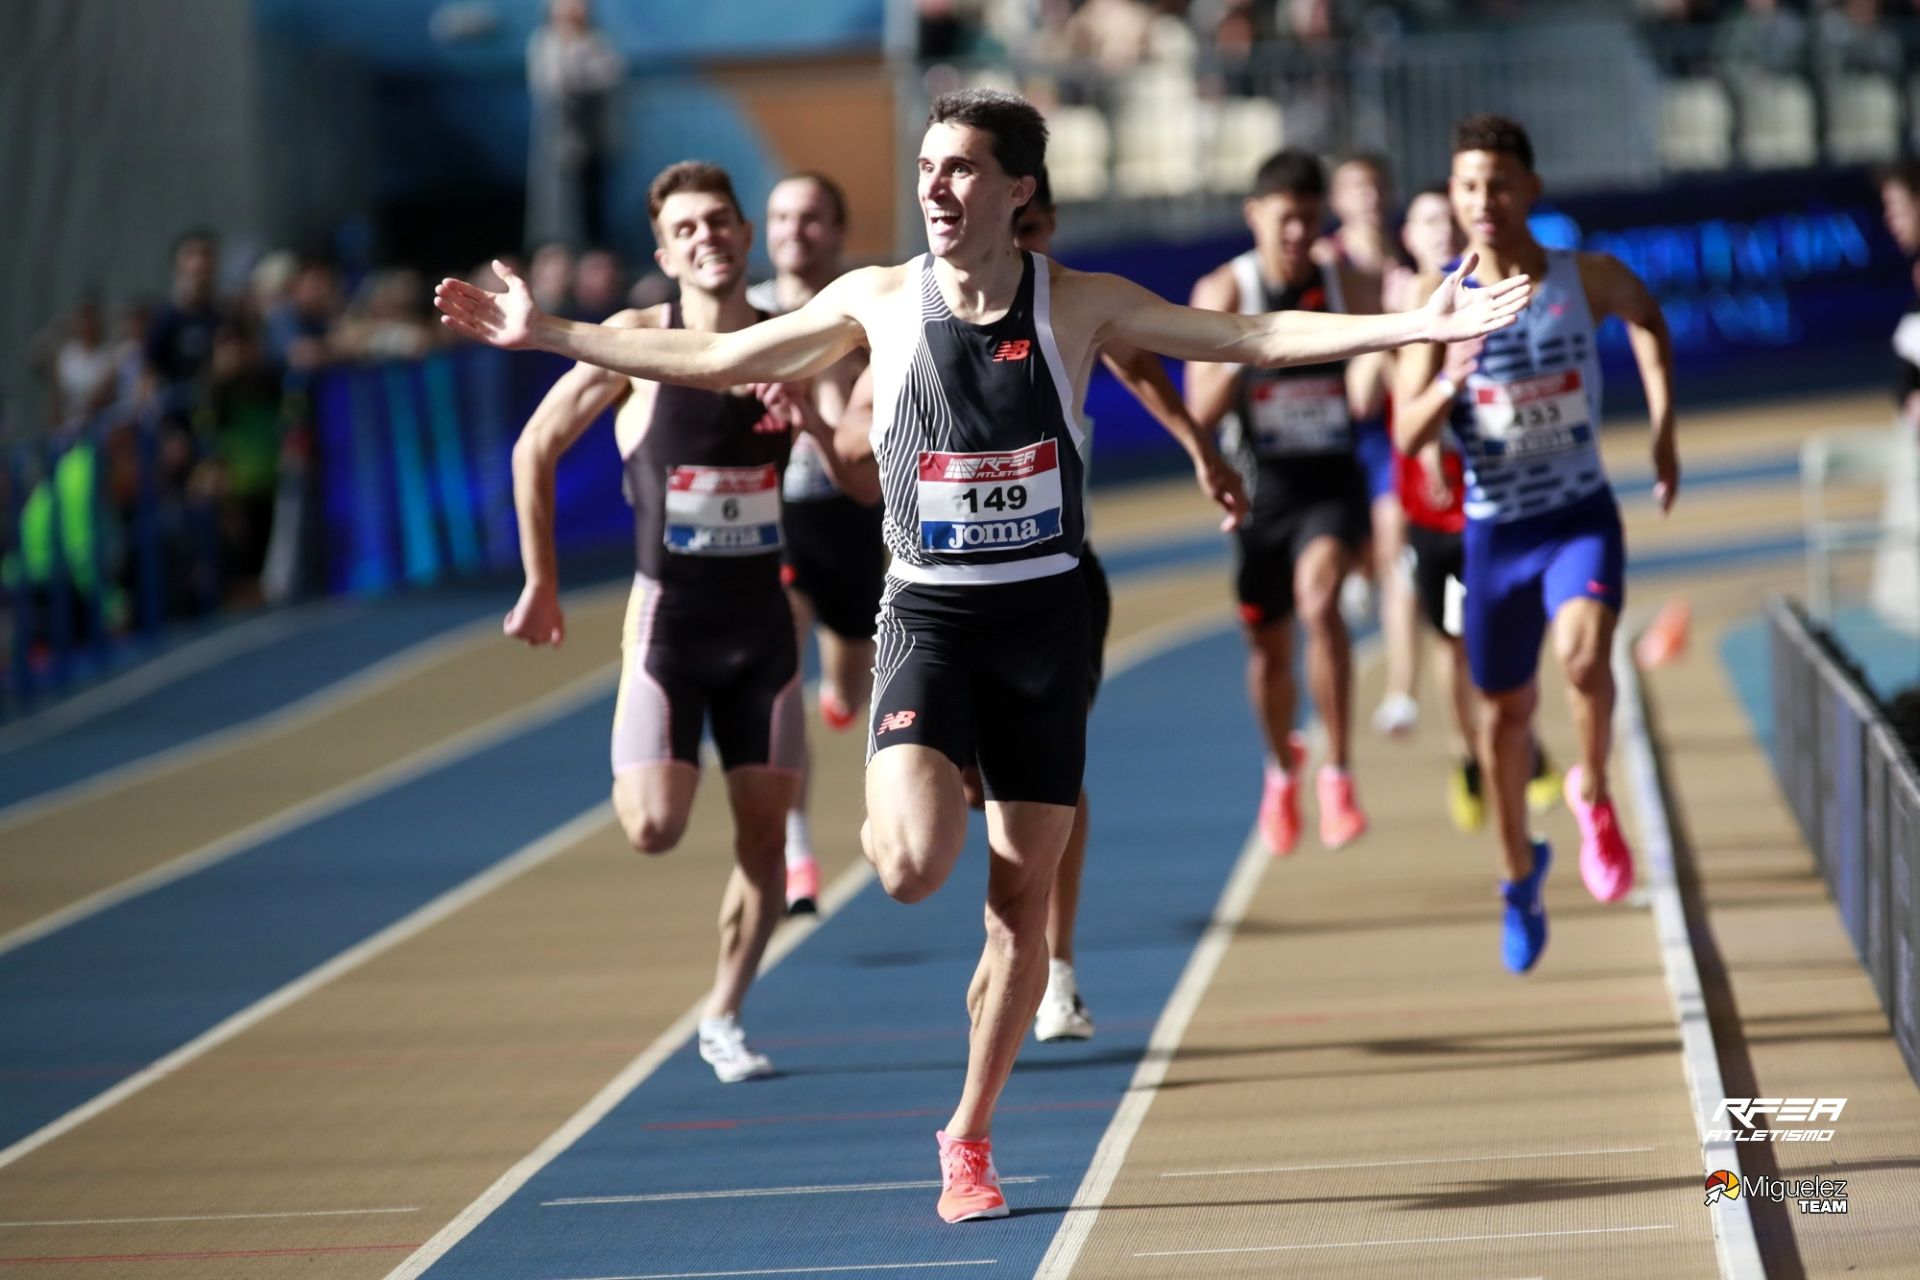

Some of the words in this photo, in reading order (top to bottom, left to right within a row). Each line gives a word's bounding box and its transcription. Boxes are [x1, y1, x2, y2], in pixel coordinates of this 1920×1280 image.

[979, 450, 1036, 471] RFEA
[722, 498, 738, 521] 6
[963, 485, 1027, 513] 149
